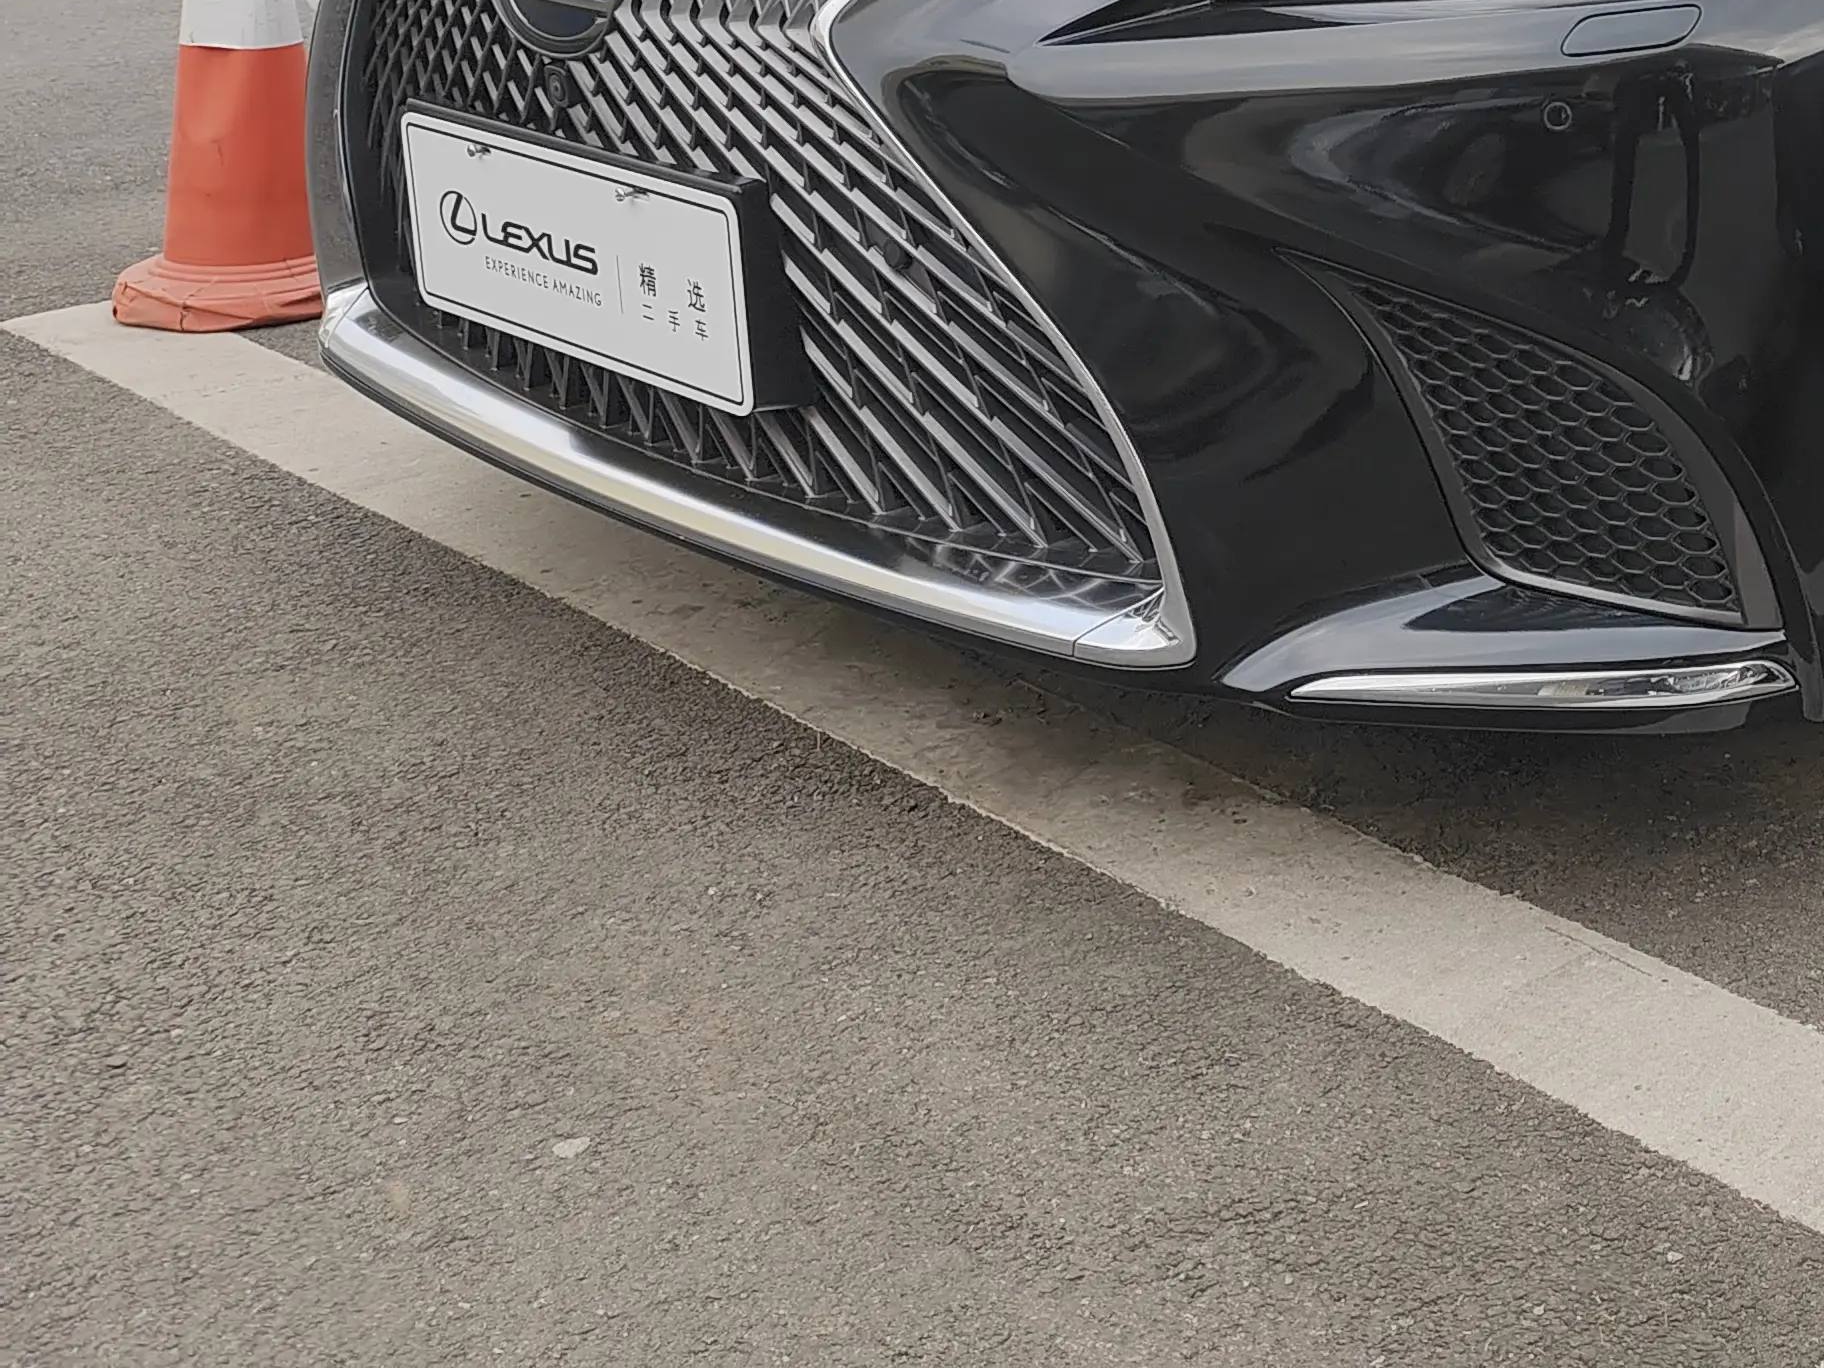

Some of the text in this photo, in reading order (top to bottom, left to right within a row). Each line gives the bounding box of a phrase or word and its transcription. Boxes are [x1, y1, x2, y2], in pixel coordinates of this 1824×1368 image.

[481, 213, 599, 275] LEXUS
[485, 255, 602, 307] EXPERIENCE AMAZING
[641, 304, 709, 342] 二手车
